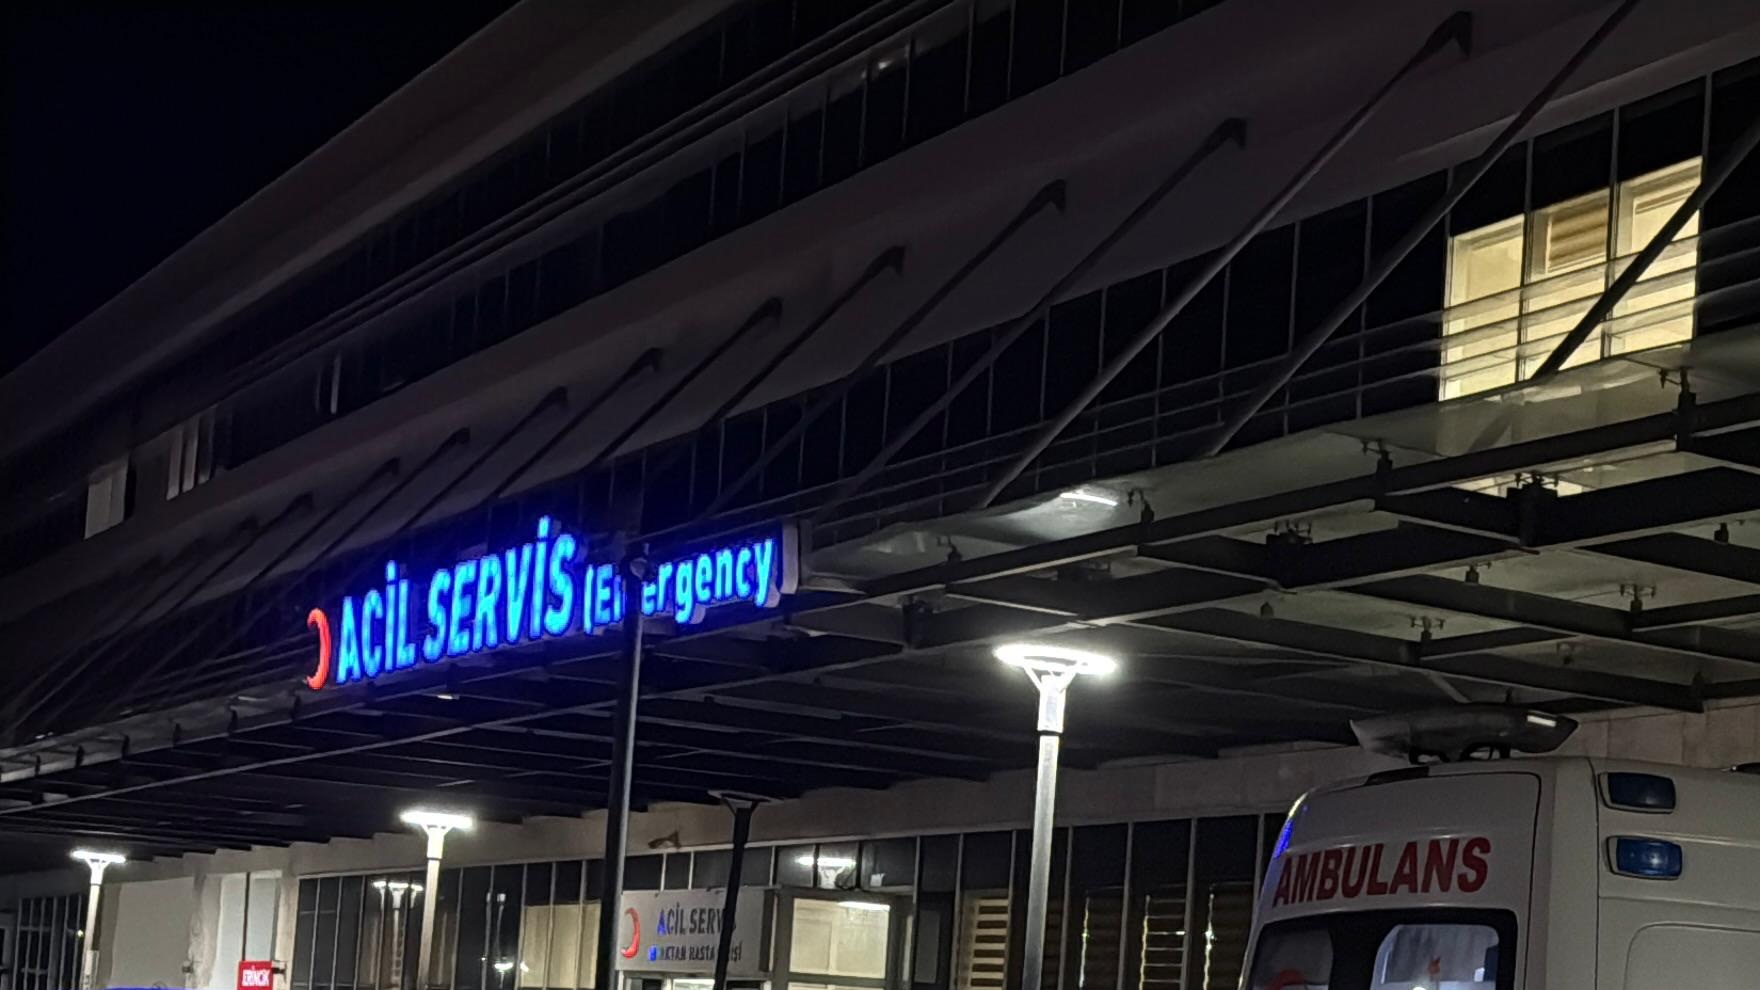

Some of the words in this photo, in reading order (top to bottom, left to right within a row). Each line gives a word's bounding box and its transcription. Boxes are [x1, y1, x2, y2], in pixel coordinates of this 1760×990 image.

[336, 561, 416, 684] ACİL
[422, 515, 576, 663] SERVİS
[1272, 837, 1491, 908] AMBULANS
